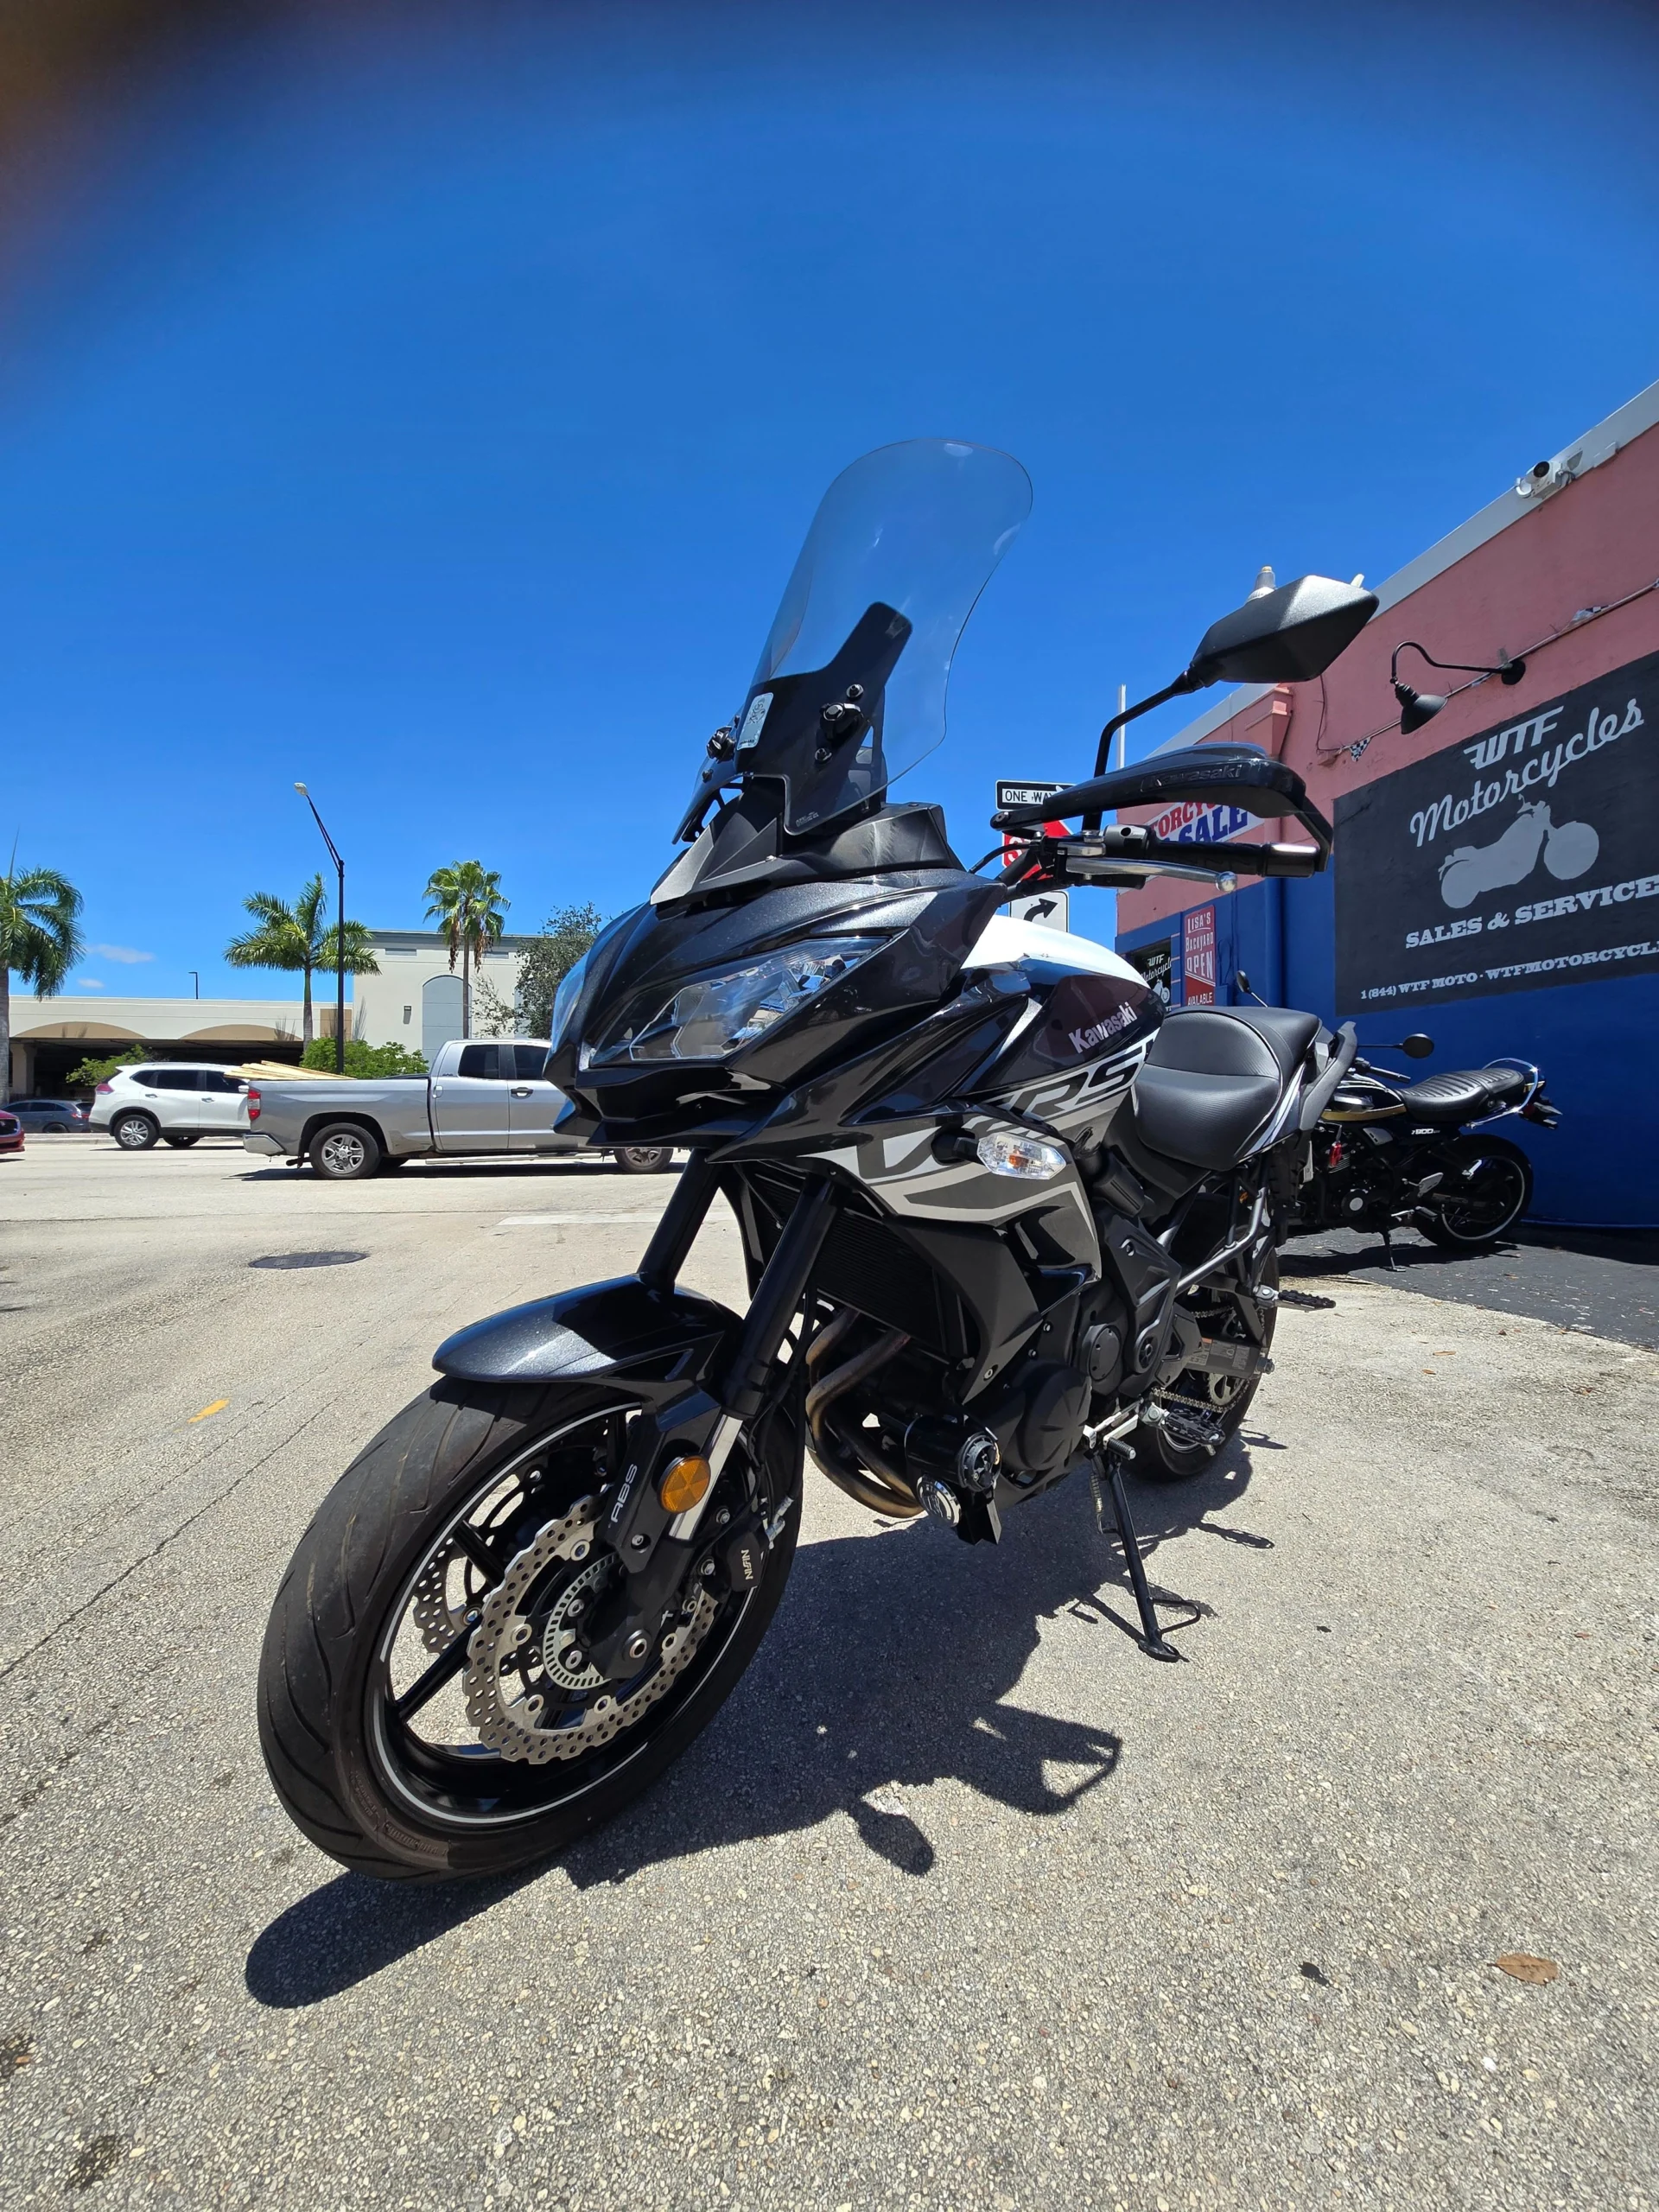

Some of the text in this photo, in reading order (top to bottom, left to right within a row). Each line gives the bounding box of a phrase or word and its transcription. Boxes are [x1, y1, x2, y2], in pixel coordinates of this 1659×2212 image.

[1464, 705, 1564, 770] WTF
[1409, 697, 1645, 848] Motorcycles
[1005, 790, 1053, 804] ONE WA
[1187, 912, 1211, 934] LISA'S
[1406, 874, 1659, 949] SALES & SERVICE
[1186, 950, 1213, 980] OPEN
[1398, 979, 1429, 993] WTF
[1432, 972, 1478, 988] MOTO
[1187, 992, 1213, 1006] AVAILABLE
[1068, 1001, 1138, 1054] Kawasaki
[610, 1463, 638, 1522] ABS
[741, 1548, 753, 1580] NISSIN
